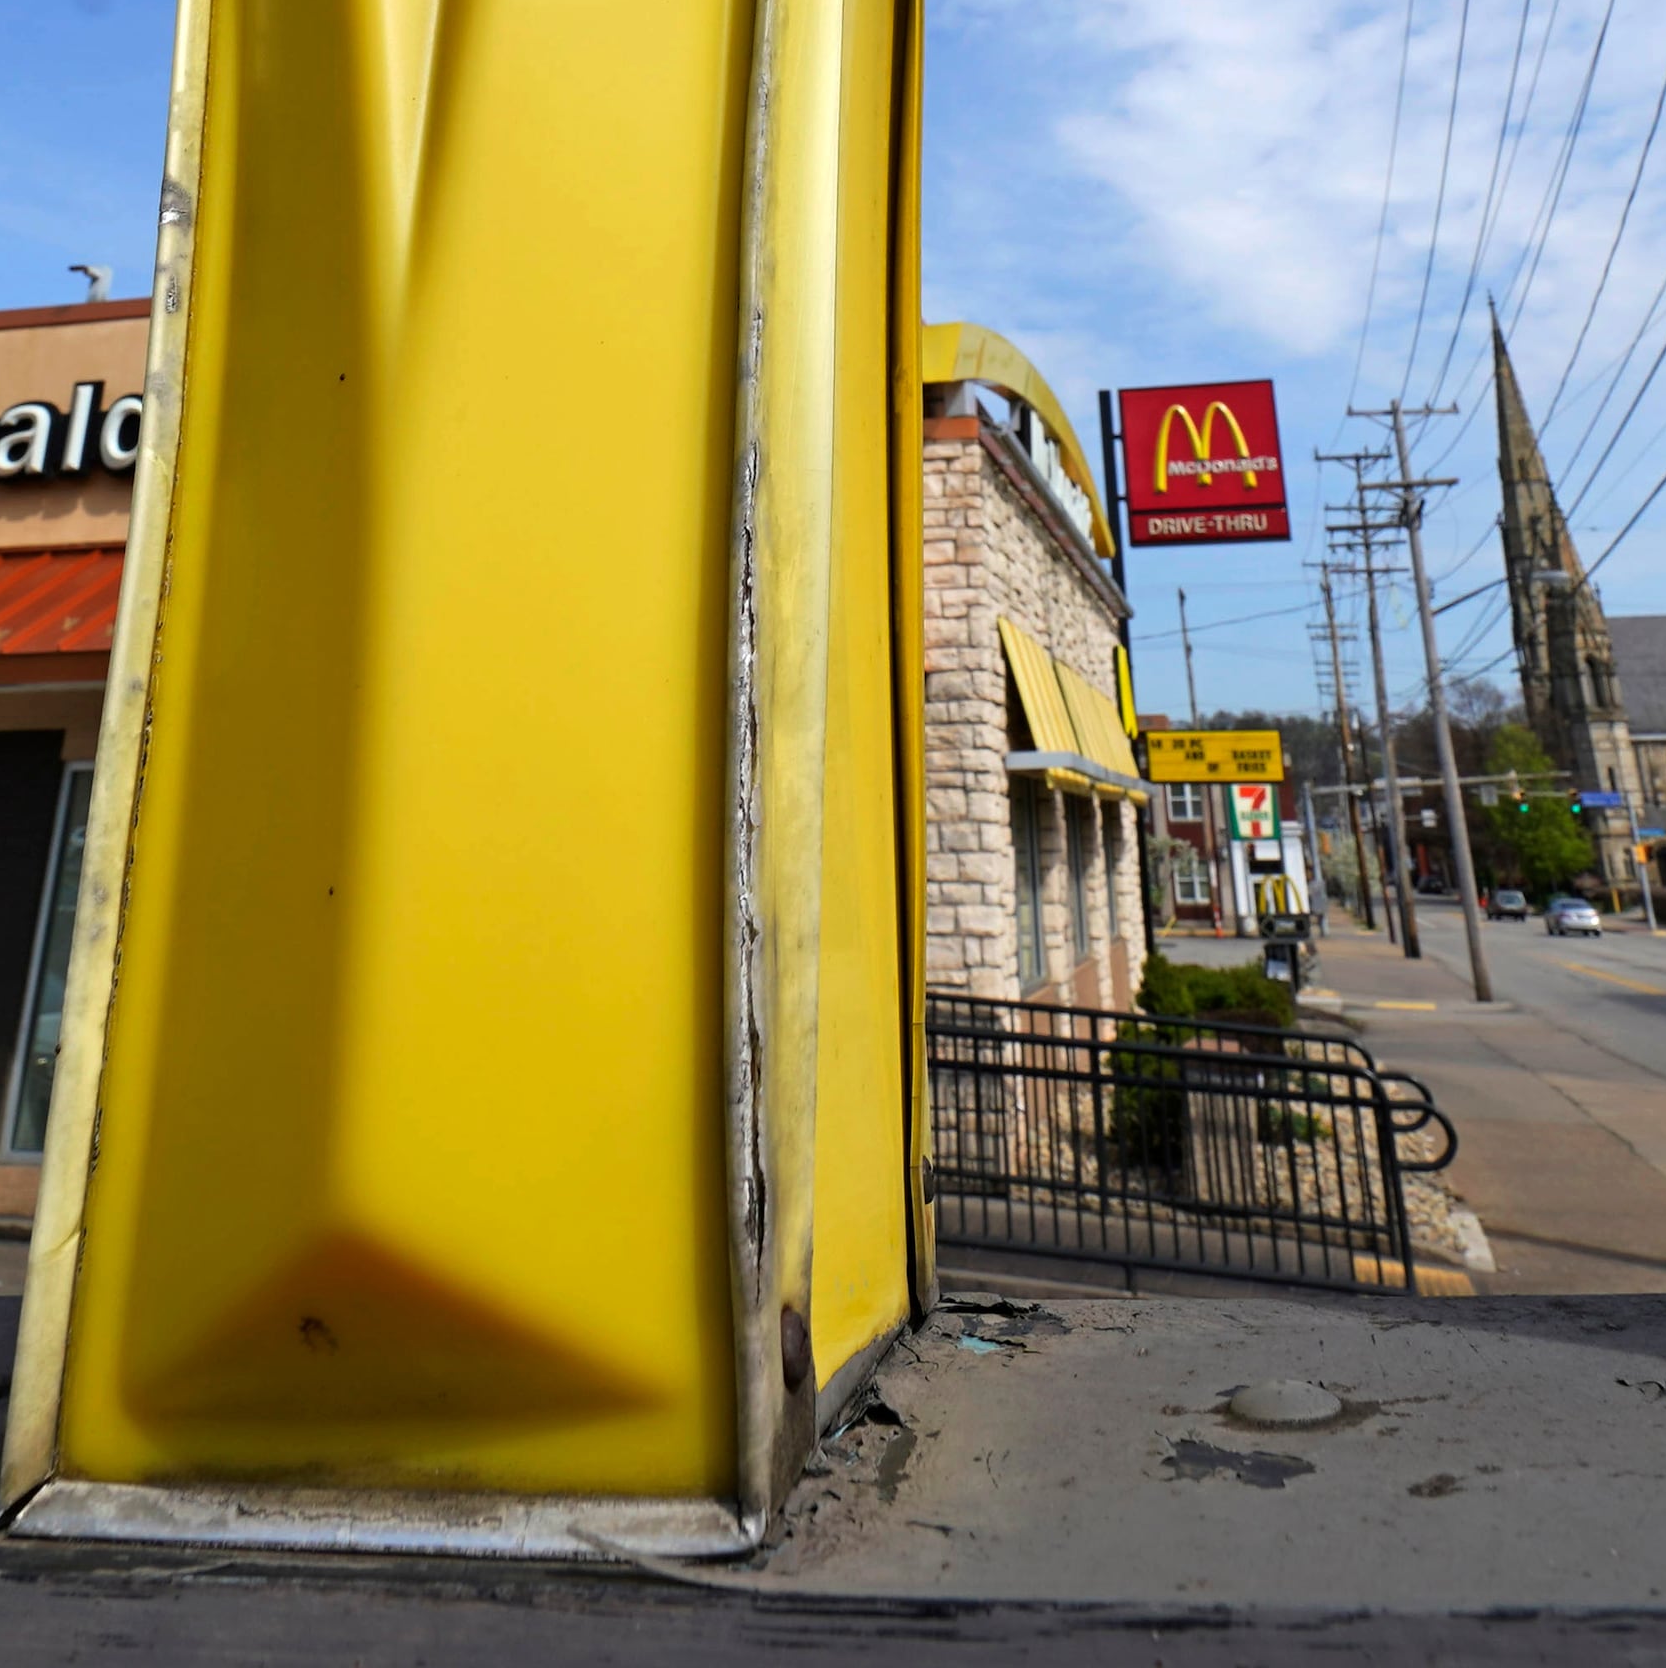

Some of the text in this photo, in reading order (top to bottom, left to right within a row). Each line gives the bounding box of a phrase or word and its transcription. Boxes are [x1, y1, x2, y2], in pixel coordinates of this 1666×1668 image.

[1167, 456, 1278, 476] McDonald's
[1148, 513, 1268, 535] DRIVE-THRU
[1239, 785, 1266, 837] 7
